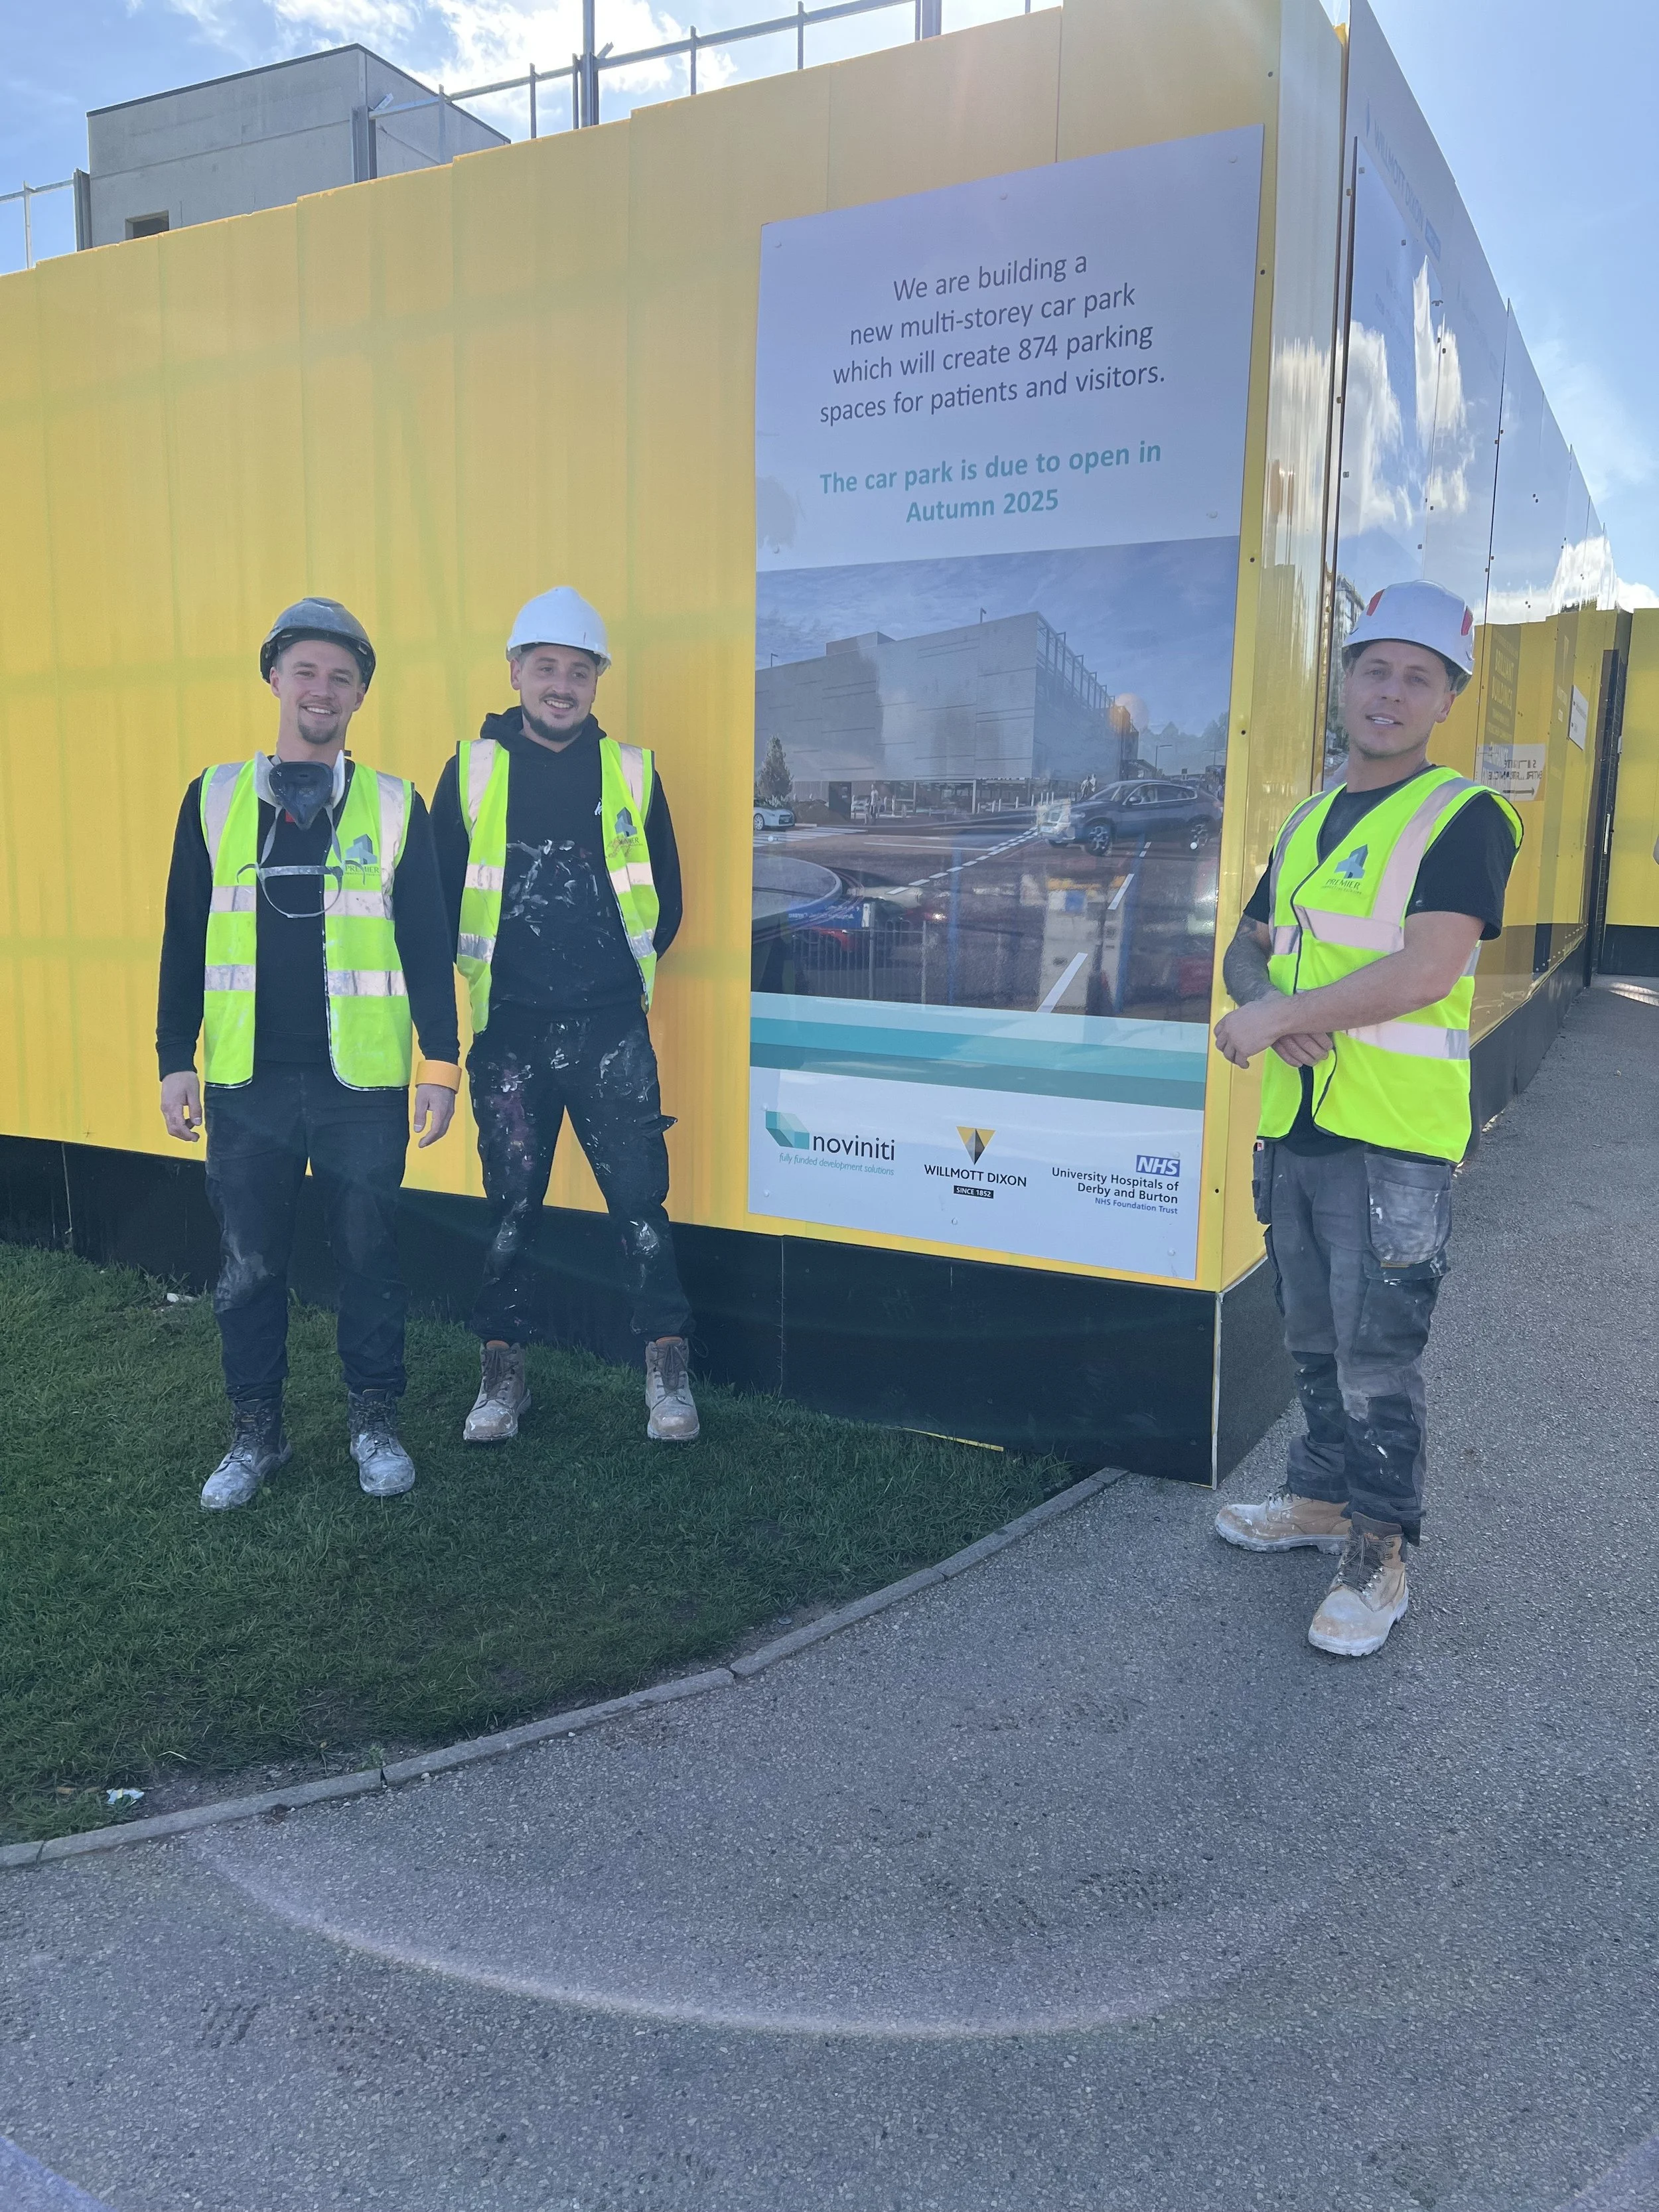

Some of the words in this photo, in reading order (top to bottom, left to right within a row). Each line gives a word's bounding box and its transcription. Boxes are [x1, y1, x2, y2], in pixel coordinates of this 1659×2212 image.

[893, 277, 928, 301] We
[935, 275, 970, 295] are
[978, 258, 1067, 289] building
[1074, 256, 1087, 274] a
[850, 324, 893, 346] new
[901, 303, 1034, 338] multi-storey
[1041, 297, 1076, 319] car
[1084, 282, 1135, 319] park
[833, 356, 892, 384] which
[900, 349, 934, 376] will
[942, 344, 1011, 370] create
[1018, 334, 1058, 361] 874
[1066, 324, 1153, 360] parking
[820, 400, 887, 427] spaces
[893, 391, 924, 414] for
[931, 382, 1018, 415] patients
[1026, 370, 1067, 399] and
[1075, 366, 1165, 393] visitors.
[820, 472, 857, 494] The
[865, 471, 897, 490] car
[904, 461, 953, 492] park
[961, 459, 977, 480] is
[985, 455, 1028, 479] due
[1035, 453, 1060, 473] to
[1069, 448, 1129, 474] open
[1139, 440, 1161, 463] in
[906, 499, 995, 523] Autumn
[1003, 488, 1058, 514] 2025
[1326, 878, 1360, 890] PREMIER
[813, 1134, 895, 1161] noviniti
[779, 1152, 793, 1164] fully
[794, 1154, 818, 1165] funded
[819, 1158, 863, 1171] development
[864, 1164, 895, 1176] solutions
[924, 1163, 984, 1181] WILLMOTT
[987, 1172, 1027, 1187] DIXON
[1137, 1156, 1179, 1176] NHS
[1052, 1167, 1108, 1185] University
[1111, 1174, 1163, 1189] Hospitals
[1167, 1181, 1179, 1191] of
[956, 1187, 975, 1195] SINCE
[975, 1189, 991, 1198] 1852
[1078, 1182, 1111, 1197] Derby
[1114, 1188, 1135, 1198] and
[1139, 1190, 1178, 1204] Burton
[1095, 1197, 1111, 1206] NHS
[1113, 1199, 1156, 1212] Foundation
[1158, 1205, 1178, 1215] Trust
